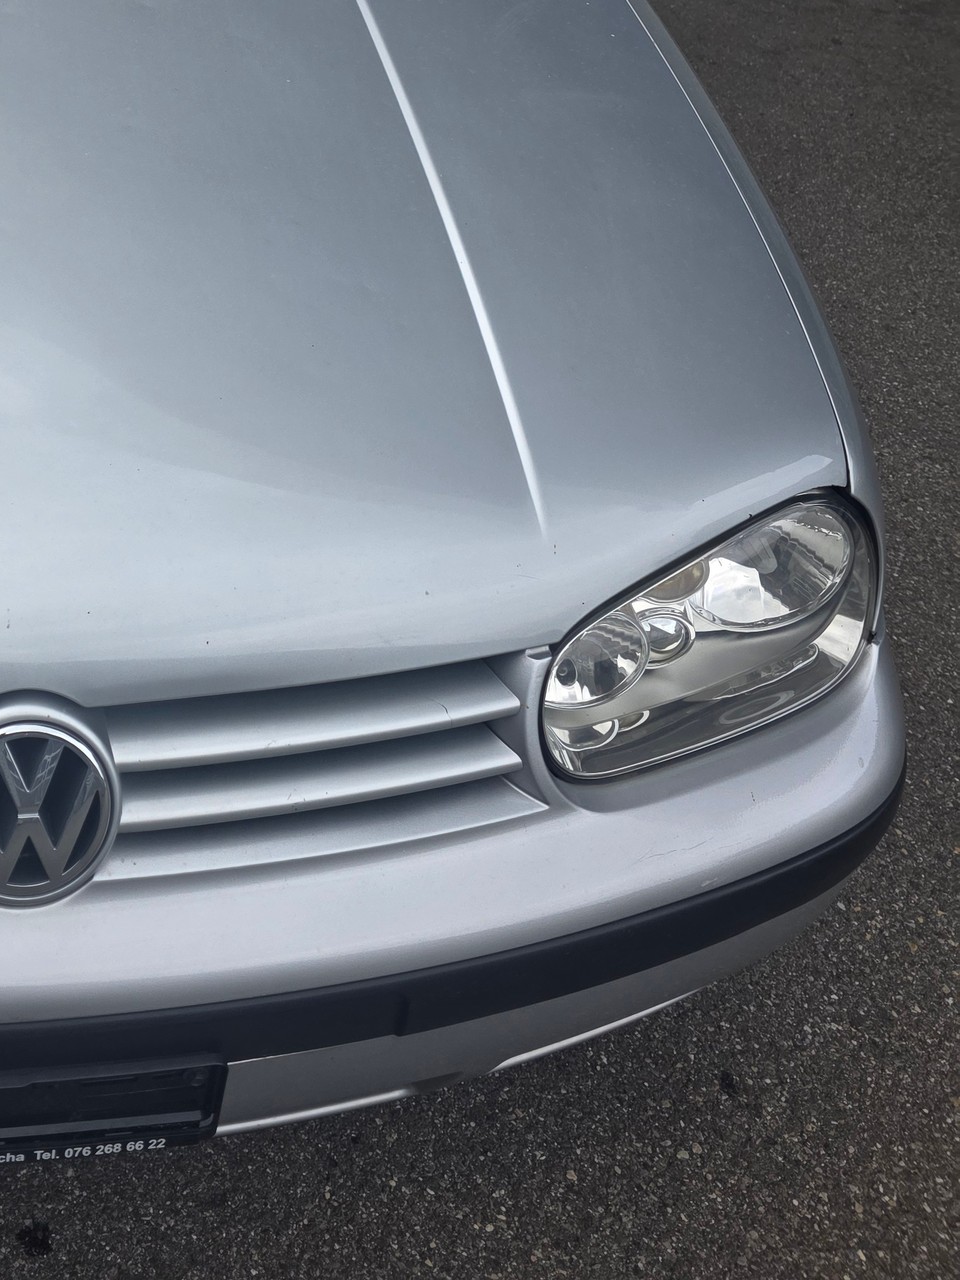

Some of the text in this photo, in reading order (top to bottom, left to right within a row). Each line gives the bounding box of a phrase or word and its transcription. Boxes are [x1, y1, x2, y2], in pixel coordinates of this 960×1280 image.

[34, 1149, 60, 1160] Tel.
[64, 1146, 91, 1158] 076
[95, 1143, 122, 1155] 268
[126, 1141, 144, 1151] 66
[148, 1138, 166, 1149] 22
